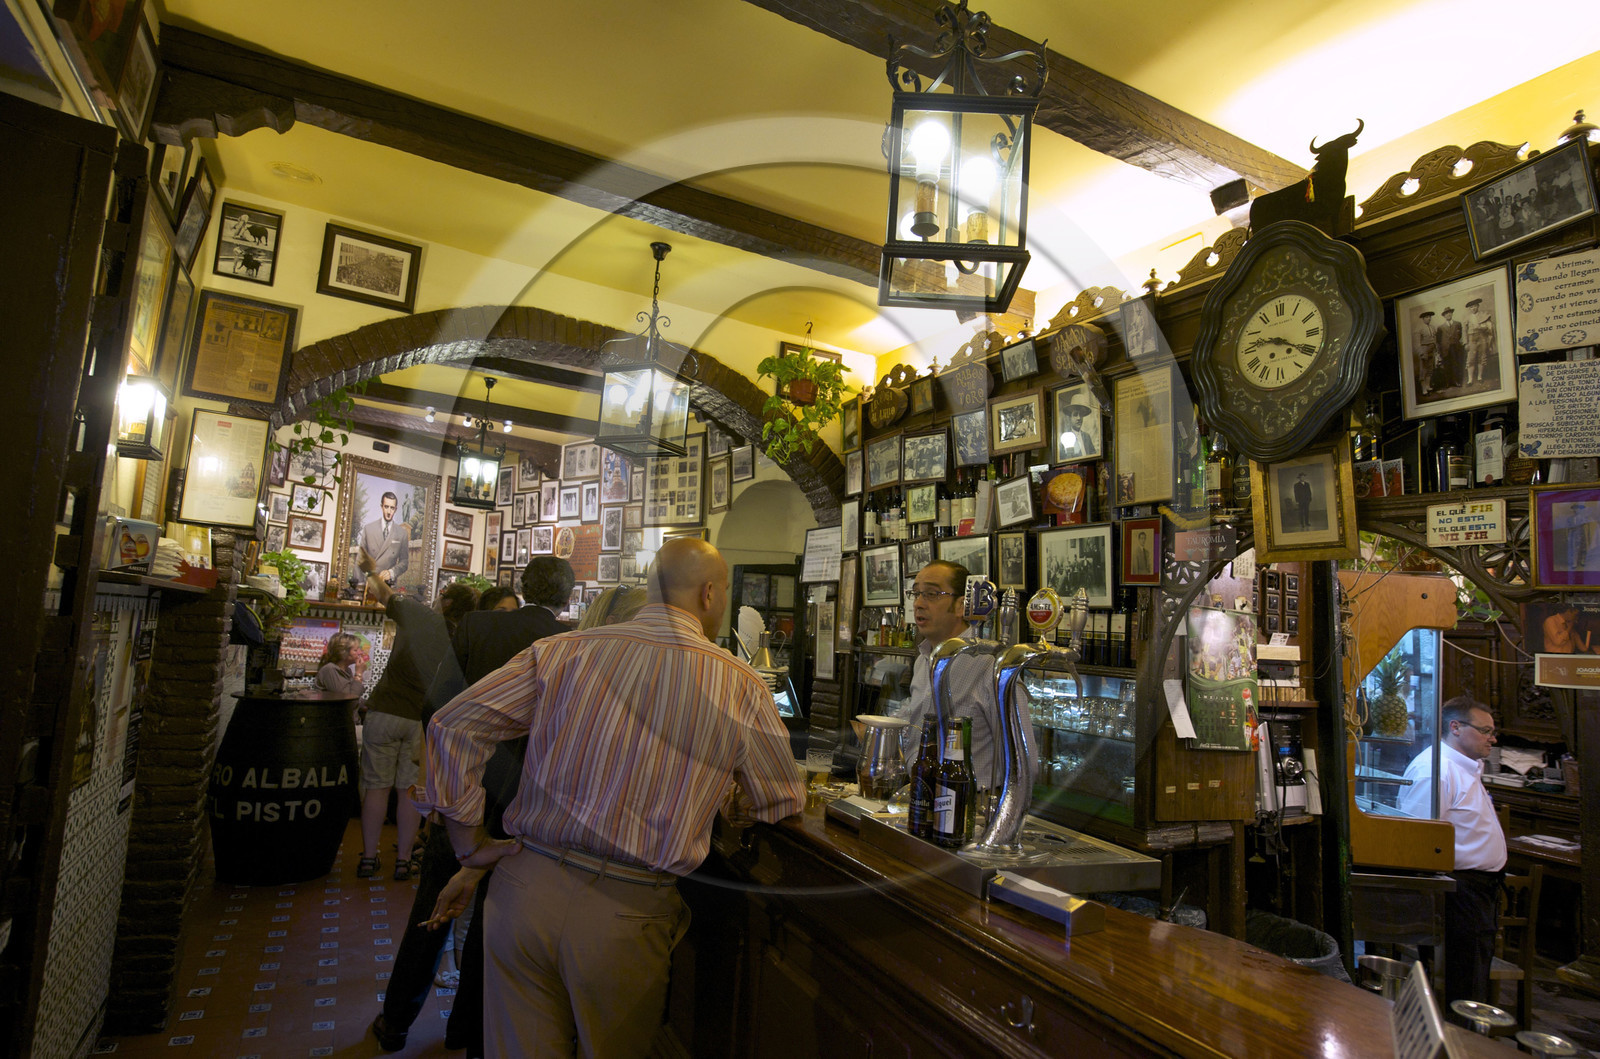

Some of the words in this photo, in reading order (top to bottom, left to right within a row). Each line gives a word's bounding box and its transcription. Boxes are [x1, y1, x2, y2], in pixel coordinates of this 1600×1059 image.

[1555, 258, 1594, 270] Abrimos,
[1537, 273, 1568, 283] cuando
[1554, 279, 1594, 290] cerramos
[1535, 293, 1566, 303] cuando
[1568, 291, 1584, 299] nos
[1569, 298, 1598, 308] vienes
[1538, 325, 1553, 334] que
[1556, 368, 1589, 376] DIRIGIRSE
[955, 368, 984, 388] RABOS
[967, 381, 977, 391] DE
[957, 388, 984, 405] TORO
[1555, 408, 1597, 416] DISCUSIONES
[1523, 432, 1563, 440] TRASTORNOS
[1449, 508, 1466, 516] QUE
[1470, 504, 1493, 513] FIA
[1457, 515, 1485, 523] ESTA
[1468, 523, 1496, 531] ESTA
[1439, 532, 1459, 542] NO
[1464, 531, 1488, 540] FIA
[1030, 603, 1052, 611] AMSTEL
[242, 764, 349, 789] ALBALA
[236, 798, 322, 823] PISTO
